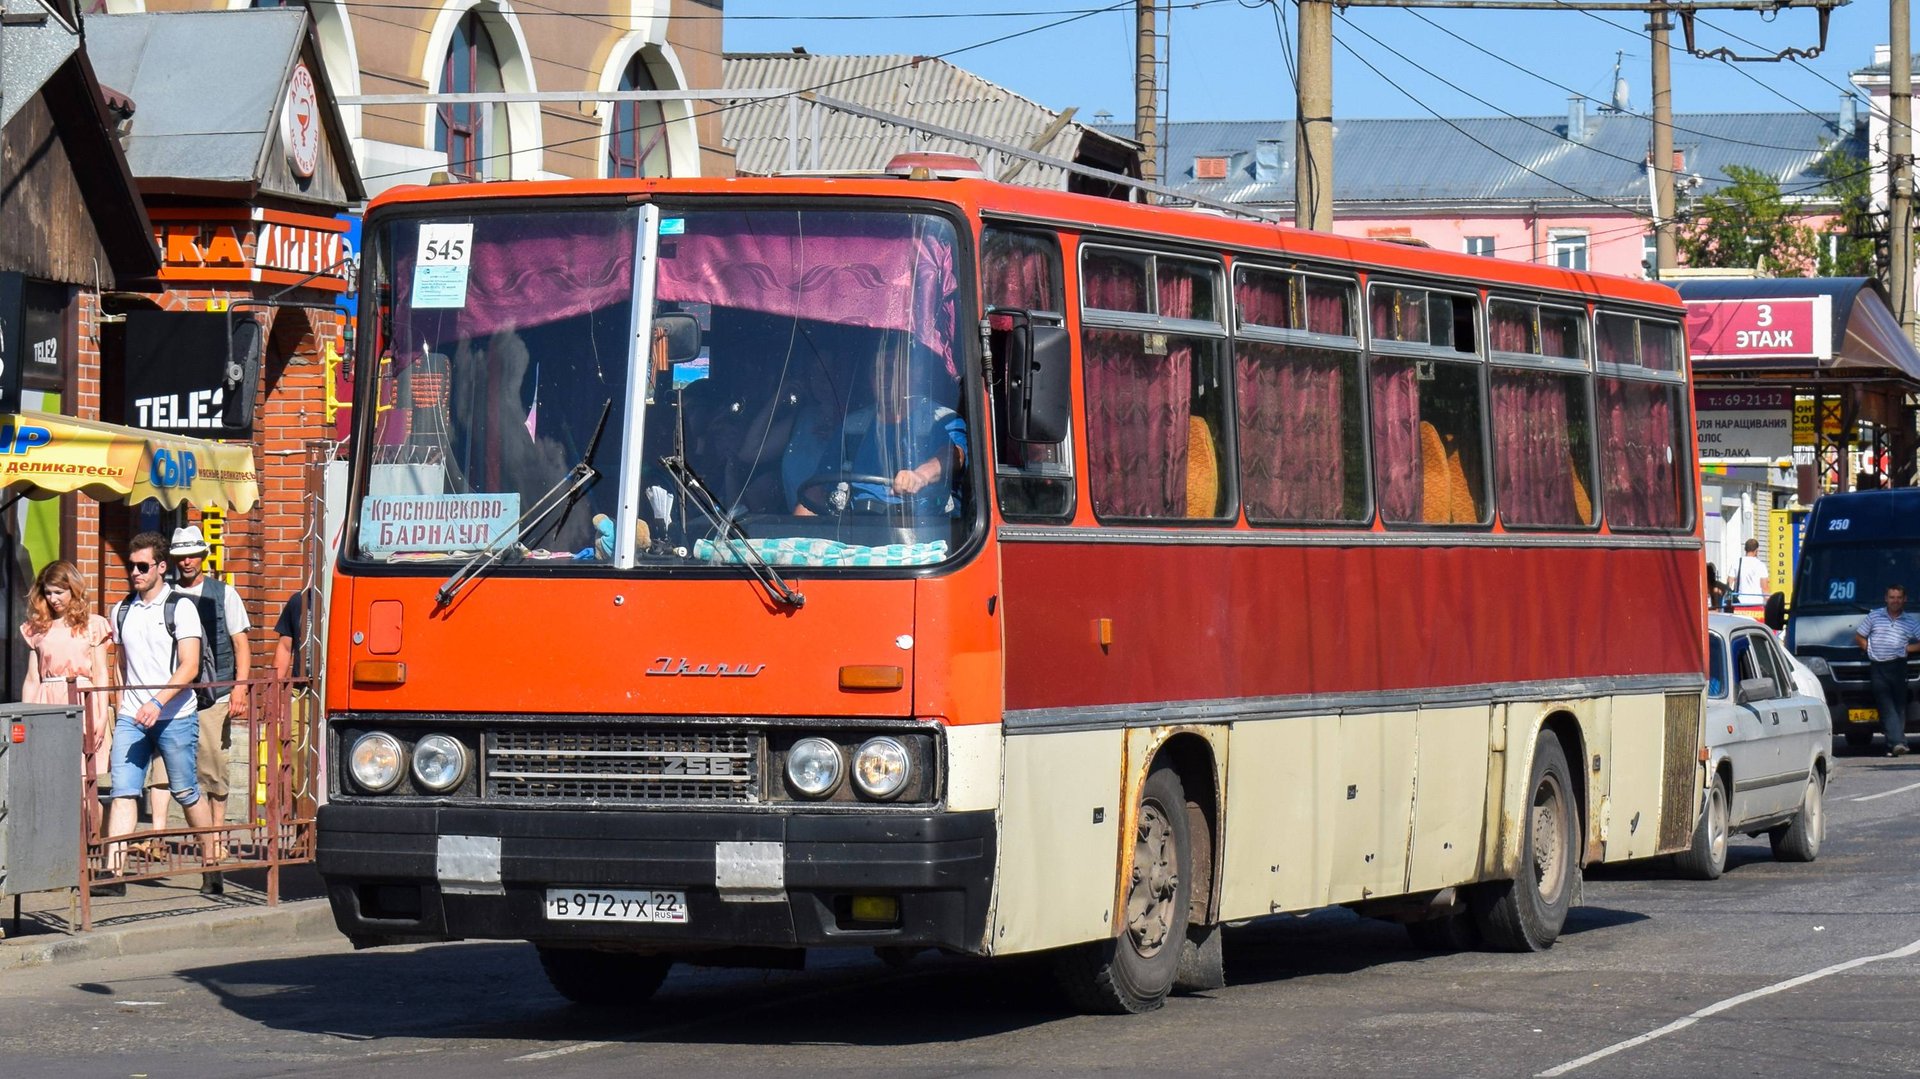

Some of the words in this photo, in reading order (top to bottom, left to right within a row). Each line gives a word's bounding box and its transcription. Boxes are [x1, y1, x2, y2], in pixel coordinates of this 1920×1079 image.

[291, 70, 315, 108] АПТЕКА
[257, 223, 347, 277] АПТЕКА
[425, 240, 465, 260] 545
[1757, 304, 1773, 327] 3
[1735, 330, 1794, 348] ЭТАЖ
[33, 337, 57, 365] TELE2
[1724, 393, 1783, 406] 69-21-12
[1714, 419, 1787, 430] НАРАЩИВАНИЯ
[6, 461, 124, 477] деликатесы
[150, 448, 197, 489] СЫР
[379, 522, 489, 546] БАРНАУЛ
[1828, 518, 1850, 531] 250
[1777, 516, 1786, 585] ТОРГОВЫЙ
[1829, 581, 1856, 600] 250
[645, 656, 766, 678] Ikarus
[664, 757, 731, 776] 256
[556, 893, 649, 918] В972УХ
[654, 893, 678, 912] 22
[654, 911, 672, 919] RUS
